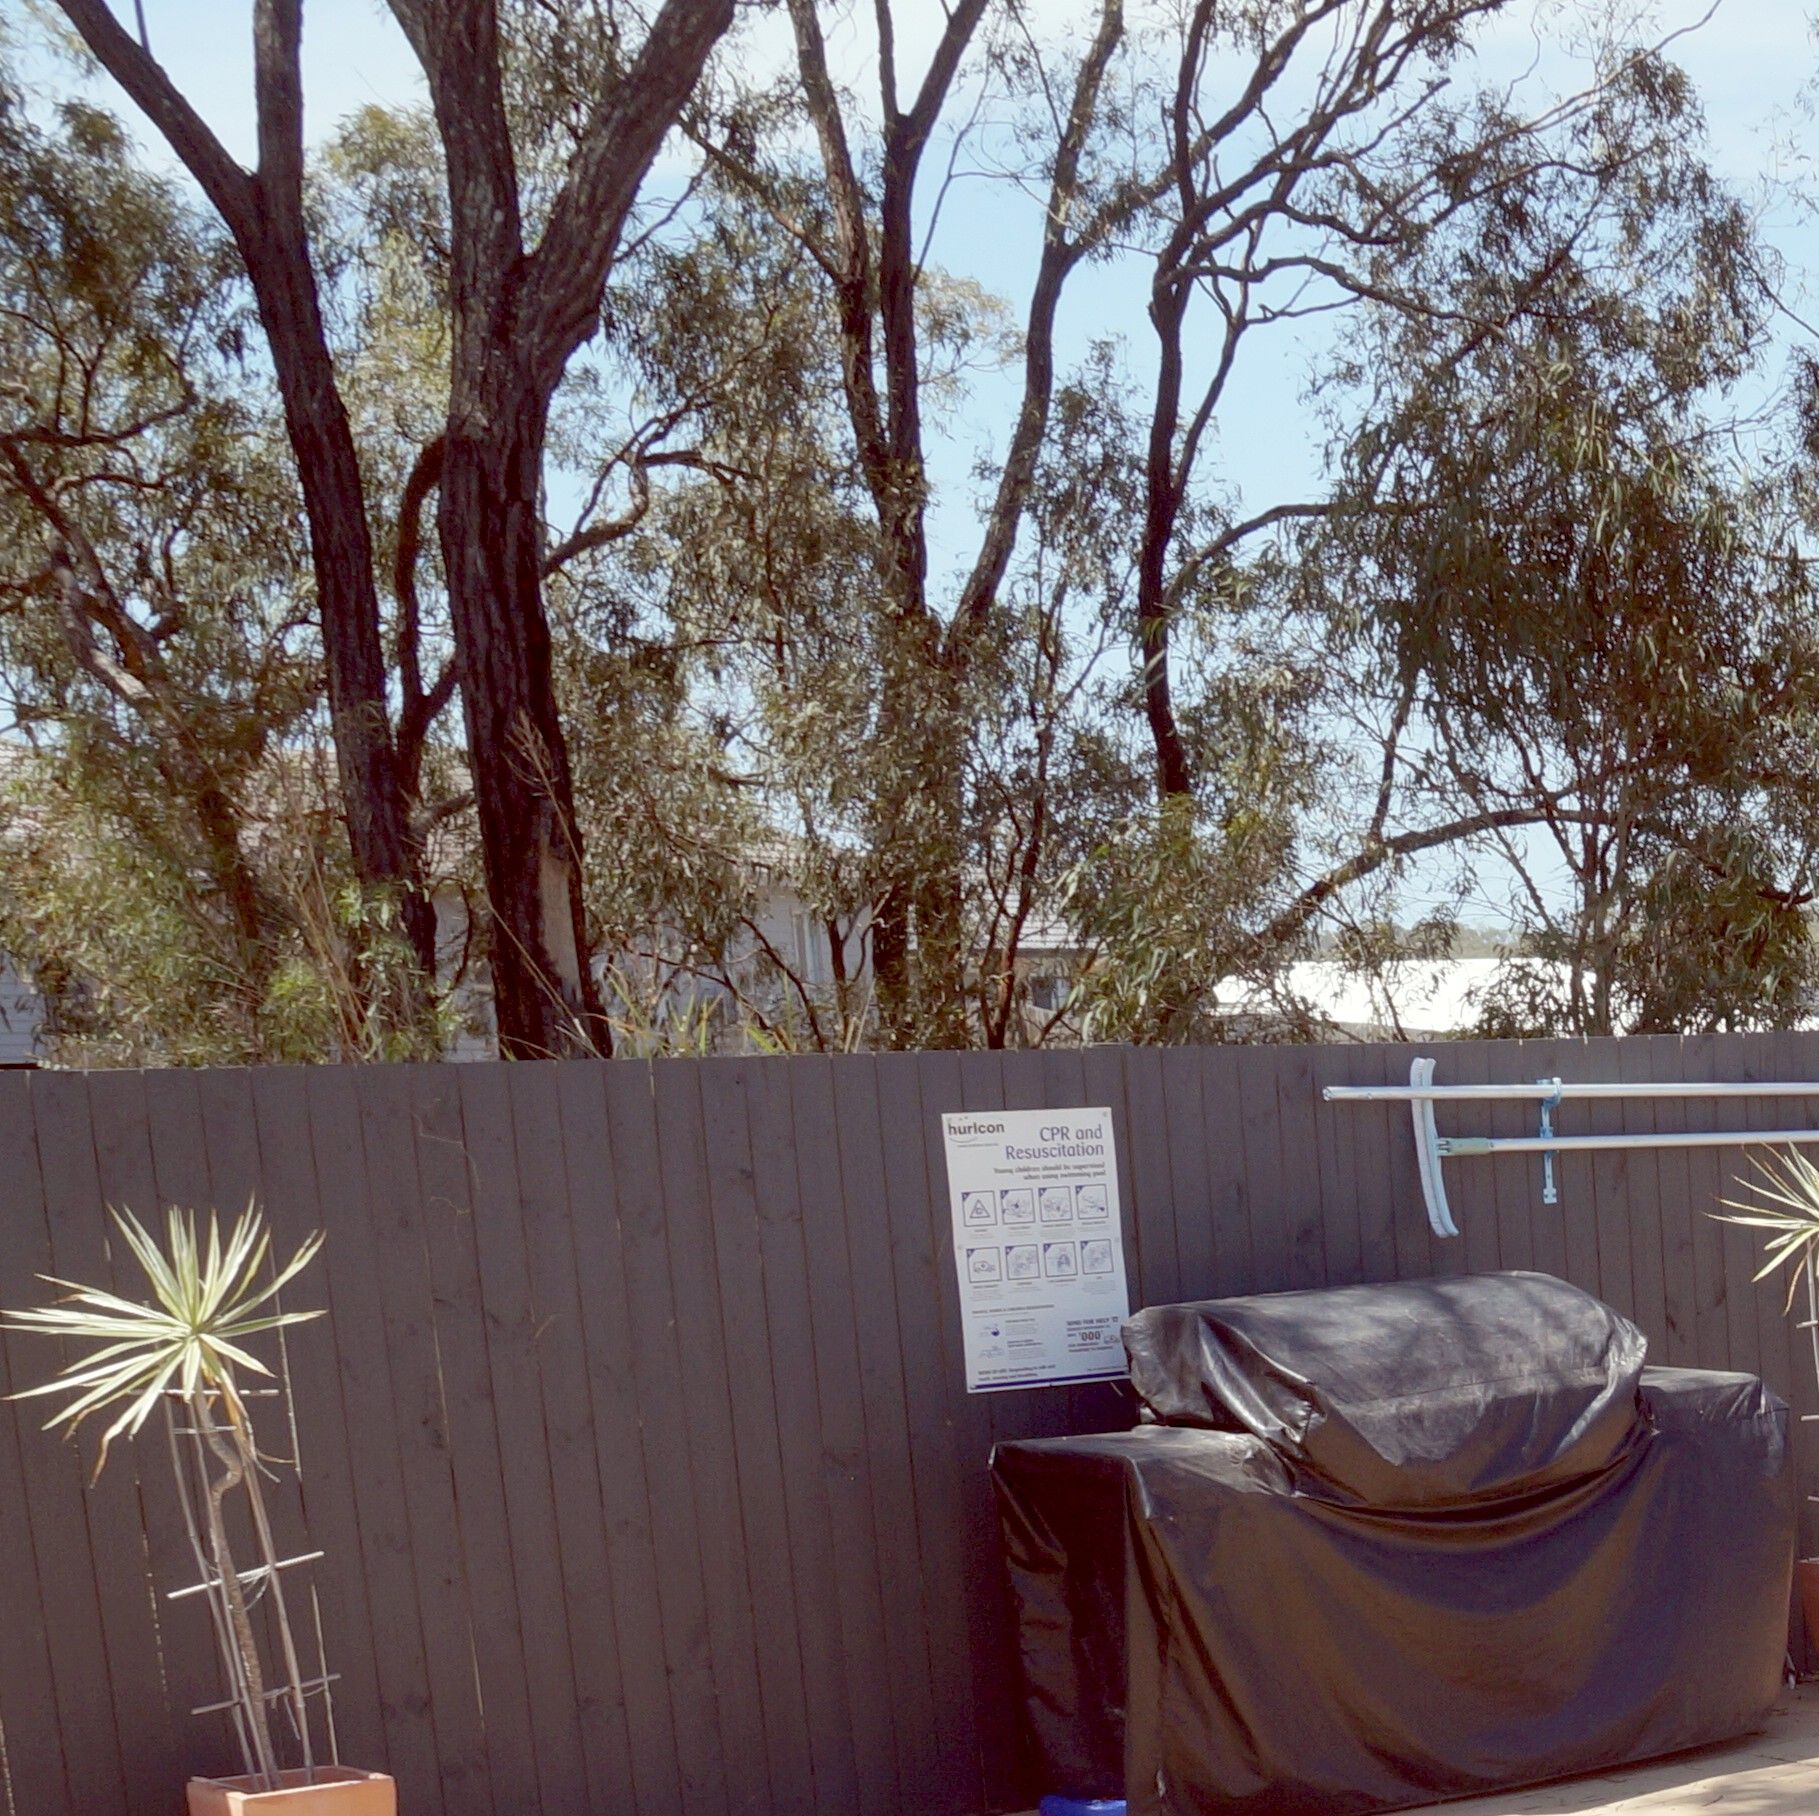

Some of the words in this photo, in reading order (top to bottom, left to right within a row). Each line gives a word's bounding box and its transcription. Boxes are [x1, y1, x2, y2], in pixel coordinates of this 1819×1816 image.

[1040, 1126, 1070, 1142] CPR
[1075, 1123, 1103, 1140] and
[1005, 1142, 1104, 1160] Resuscitation
